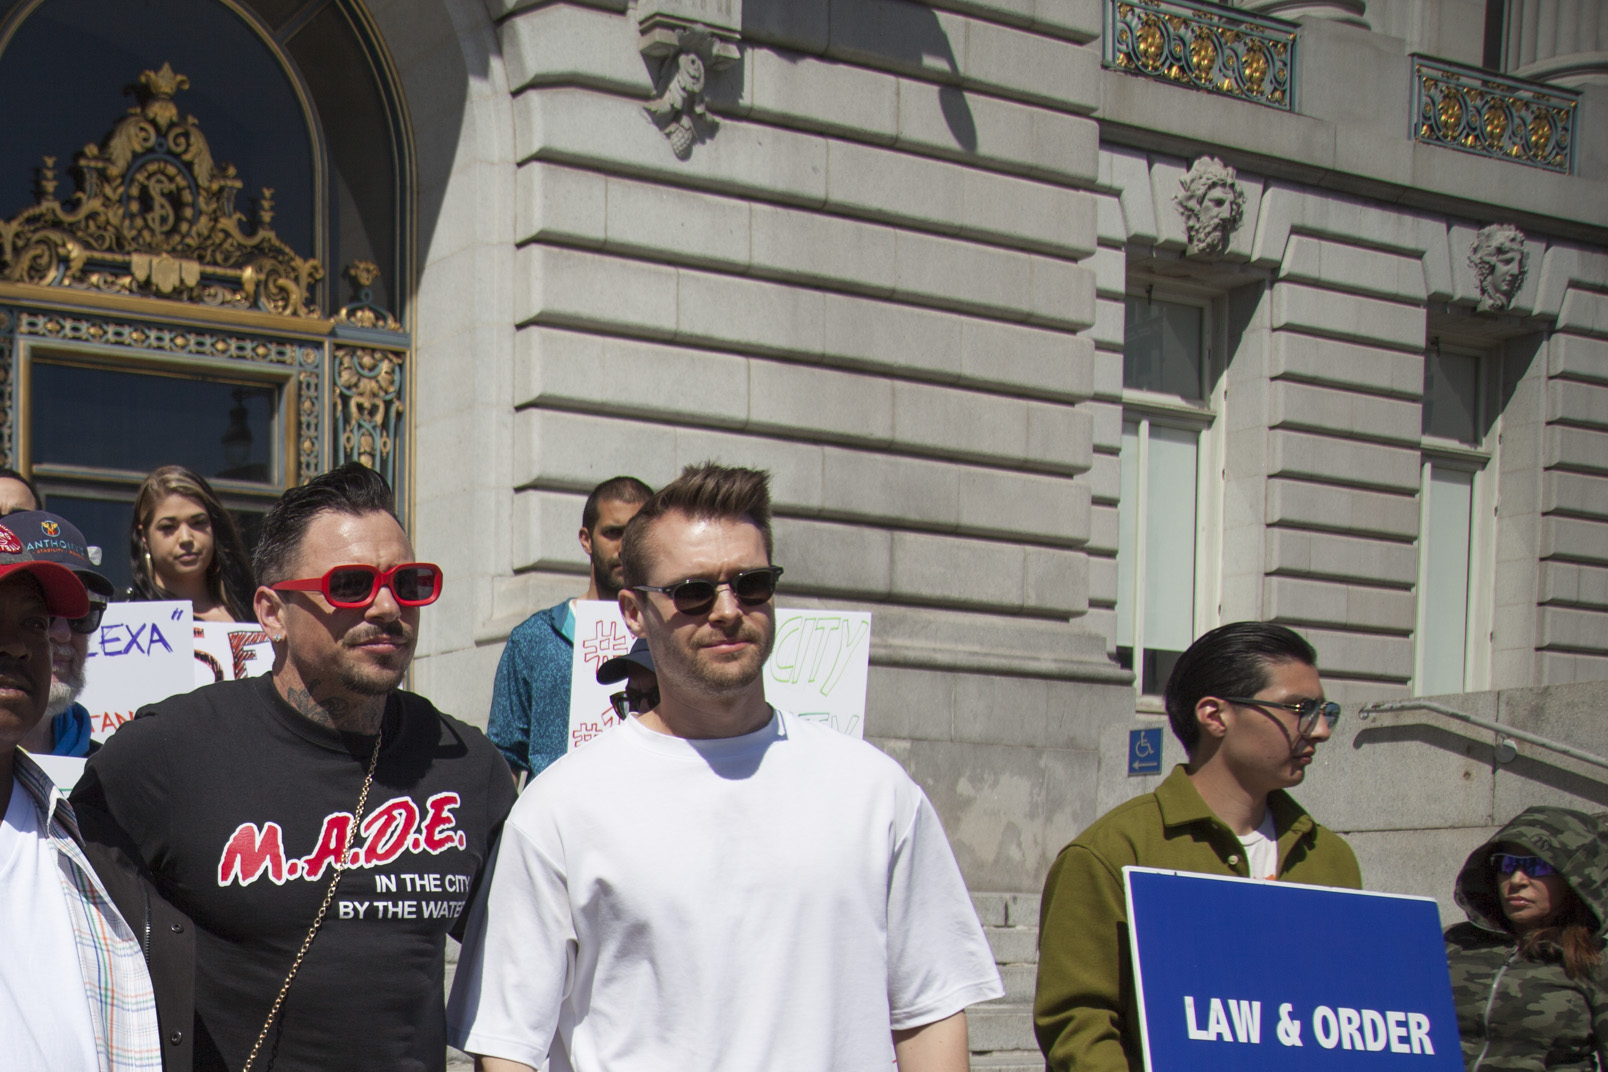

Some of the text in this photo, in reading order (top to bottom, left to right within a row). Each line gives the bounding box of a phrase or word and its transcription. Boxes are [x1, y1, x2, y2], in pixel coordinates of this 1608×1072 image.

[770, 616, 869, 697] CITY
[218, 792, 466, 887] M.A.D.E.
[339, 900, 466, 919] BY THE WATE
[375, 874, 471, 893] IN THE CITY
[1184, 996, 1435, 1055] LAW & ORDER
